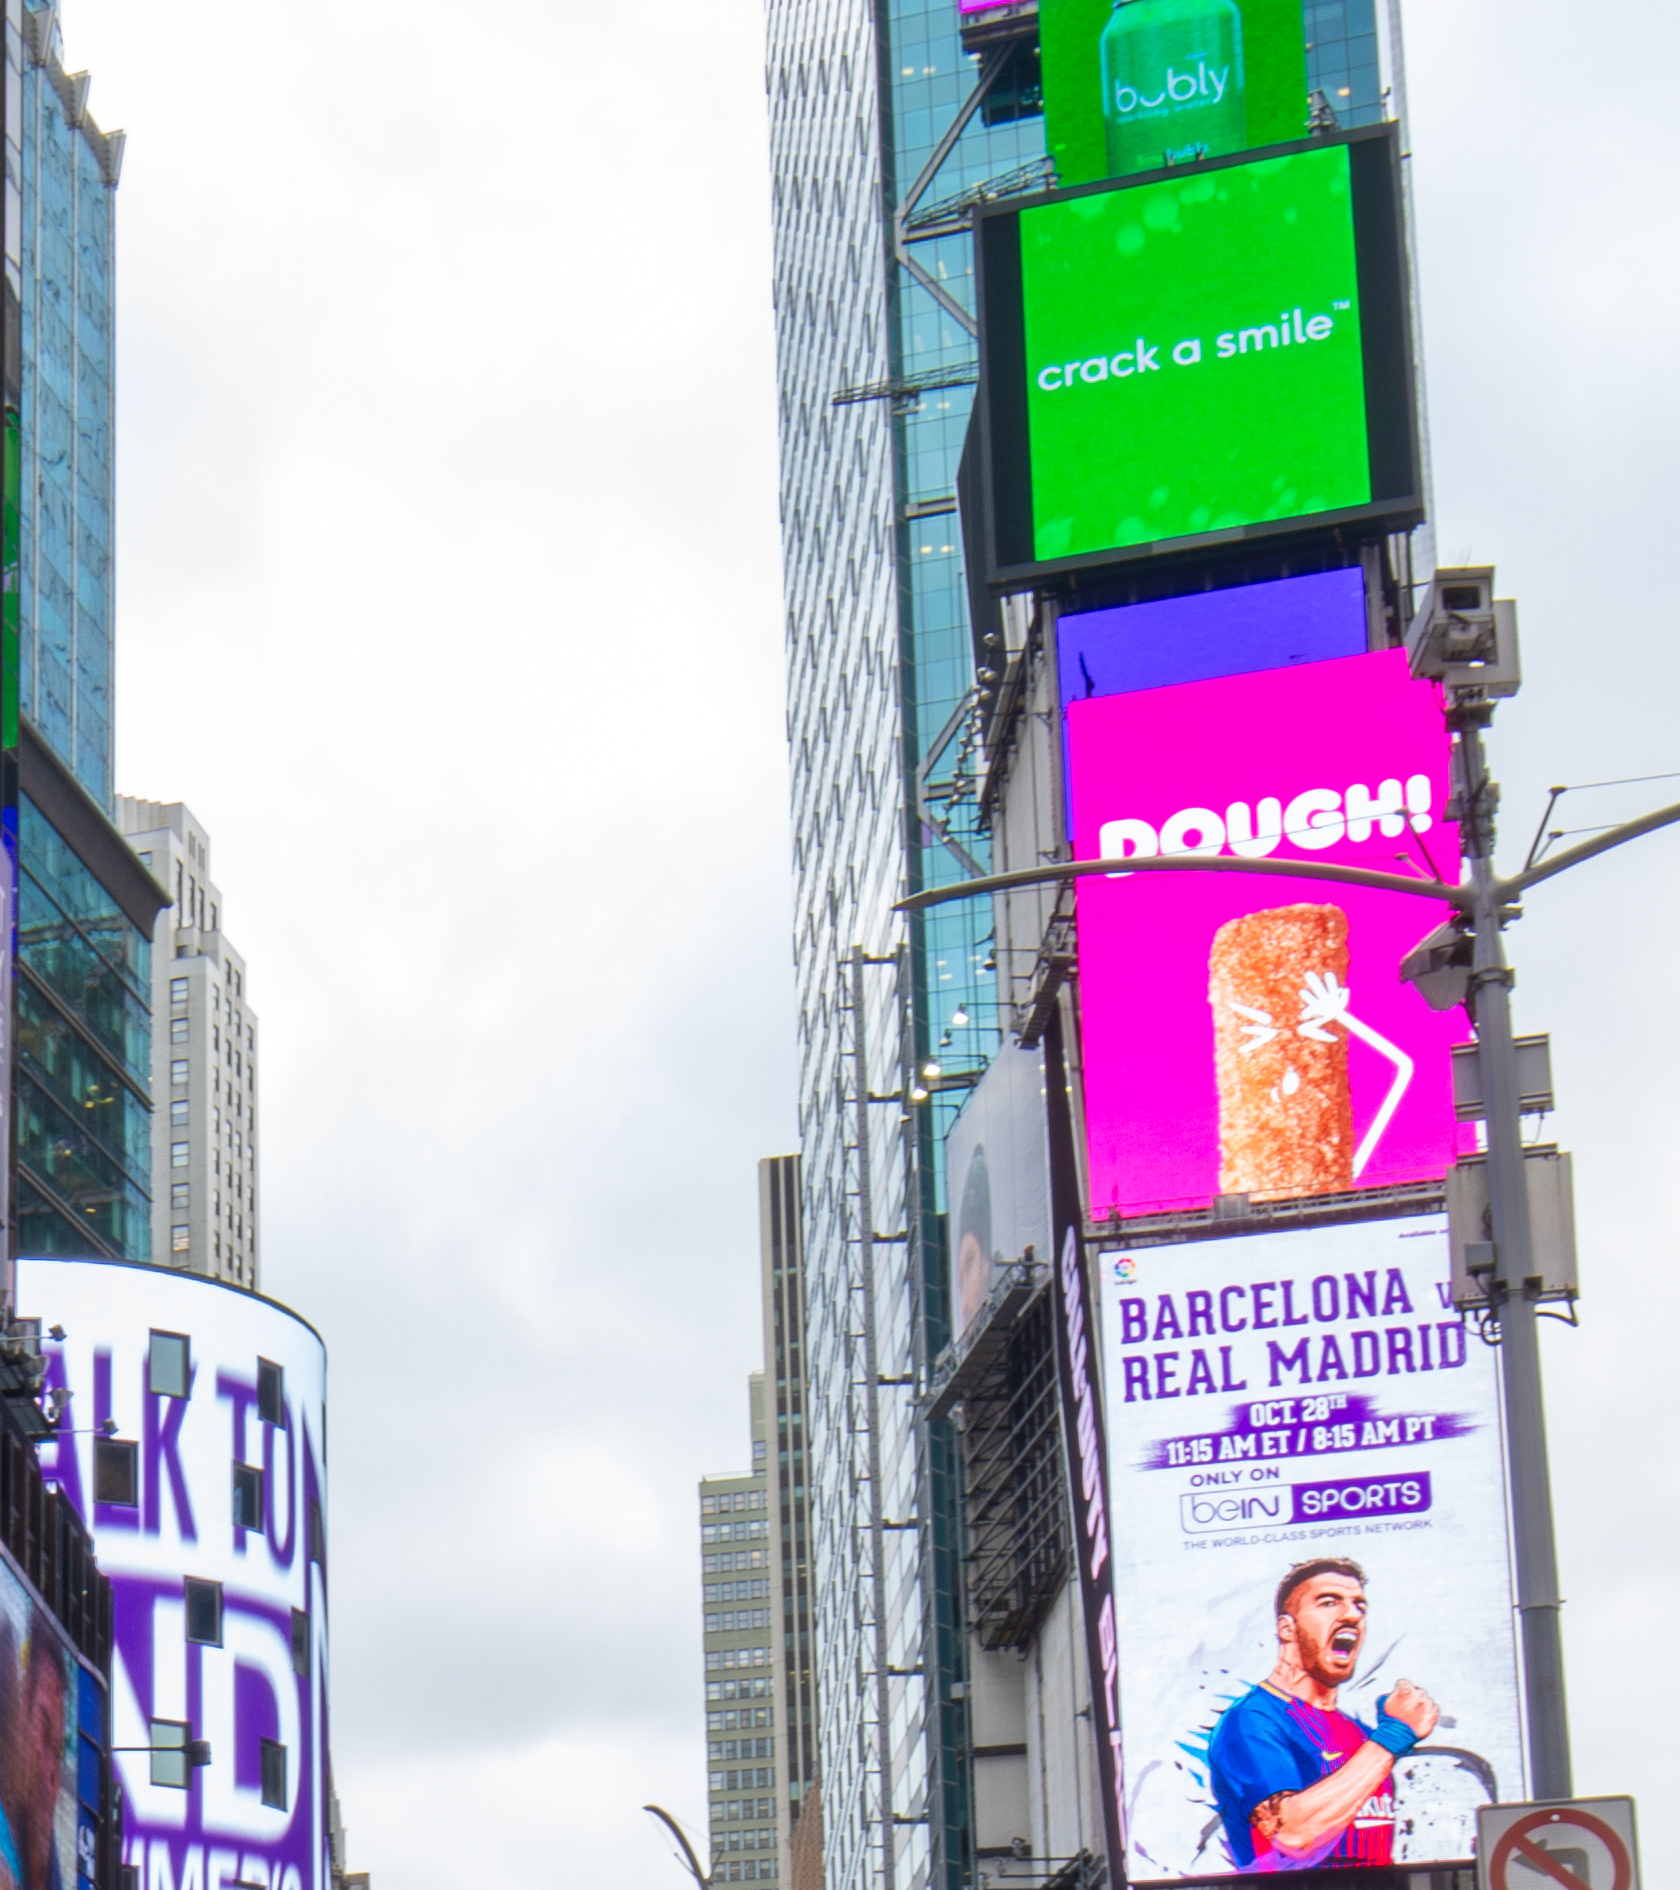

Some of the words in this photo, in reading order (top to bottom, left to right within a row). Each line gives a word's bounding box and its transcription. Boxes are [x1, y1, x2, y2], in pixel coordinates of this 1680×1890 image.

[1114, 54, 1230, 114] bubly
[1037, 338, 1160, 391] crack
[1172, 337, 1202, 366] a
[1099, 773, 1433, 878] DOUGH!
[1119, 1268, 1414, 1345] BARCELONA
[1122, 1345, 1247, 1403] REAL
[1267, 1321, 1467, 1388] MADRID
[1166, 1438, 1214, 1466] 11:15
[1218, 1434, 1257, 1460] AM
[1262, 1430, 1292, 1455] ET
[1312, 1424, 1356, 1452] 8:15
[1360, 1418, 1401, 1446] AM
[1405, 1414, 1437, 1441] PT
[1190, 1469, 1246, 1488] ONLY
[1250, 1466, 1280, 1482] ON
[1301, 1481, 1422, 1515] SPORTS
[1183, 1539, 1209, 1551] THE
[1211, 1531, 1307, 1549] WORLD-CLASS
[1309, 1525, 1362, 1540] SPORTS
[1364, 1518, 1433, 1536] NETWORK
[112, 1596, 304, 1845] ND
